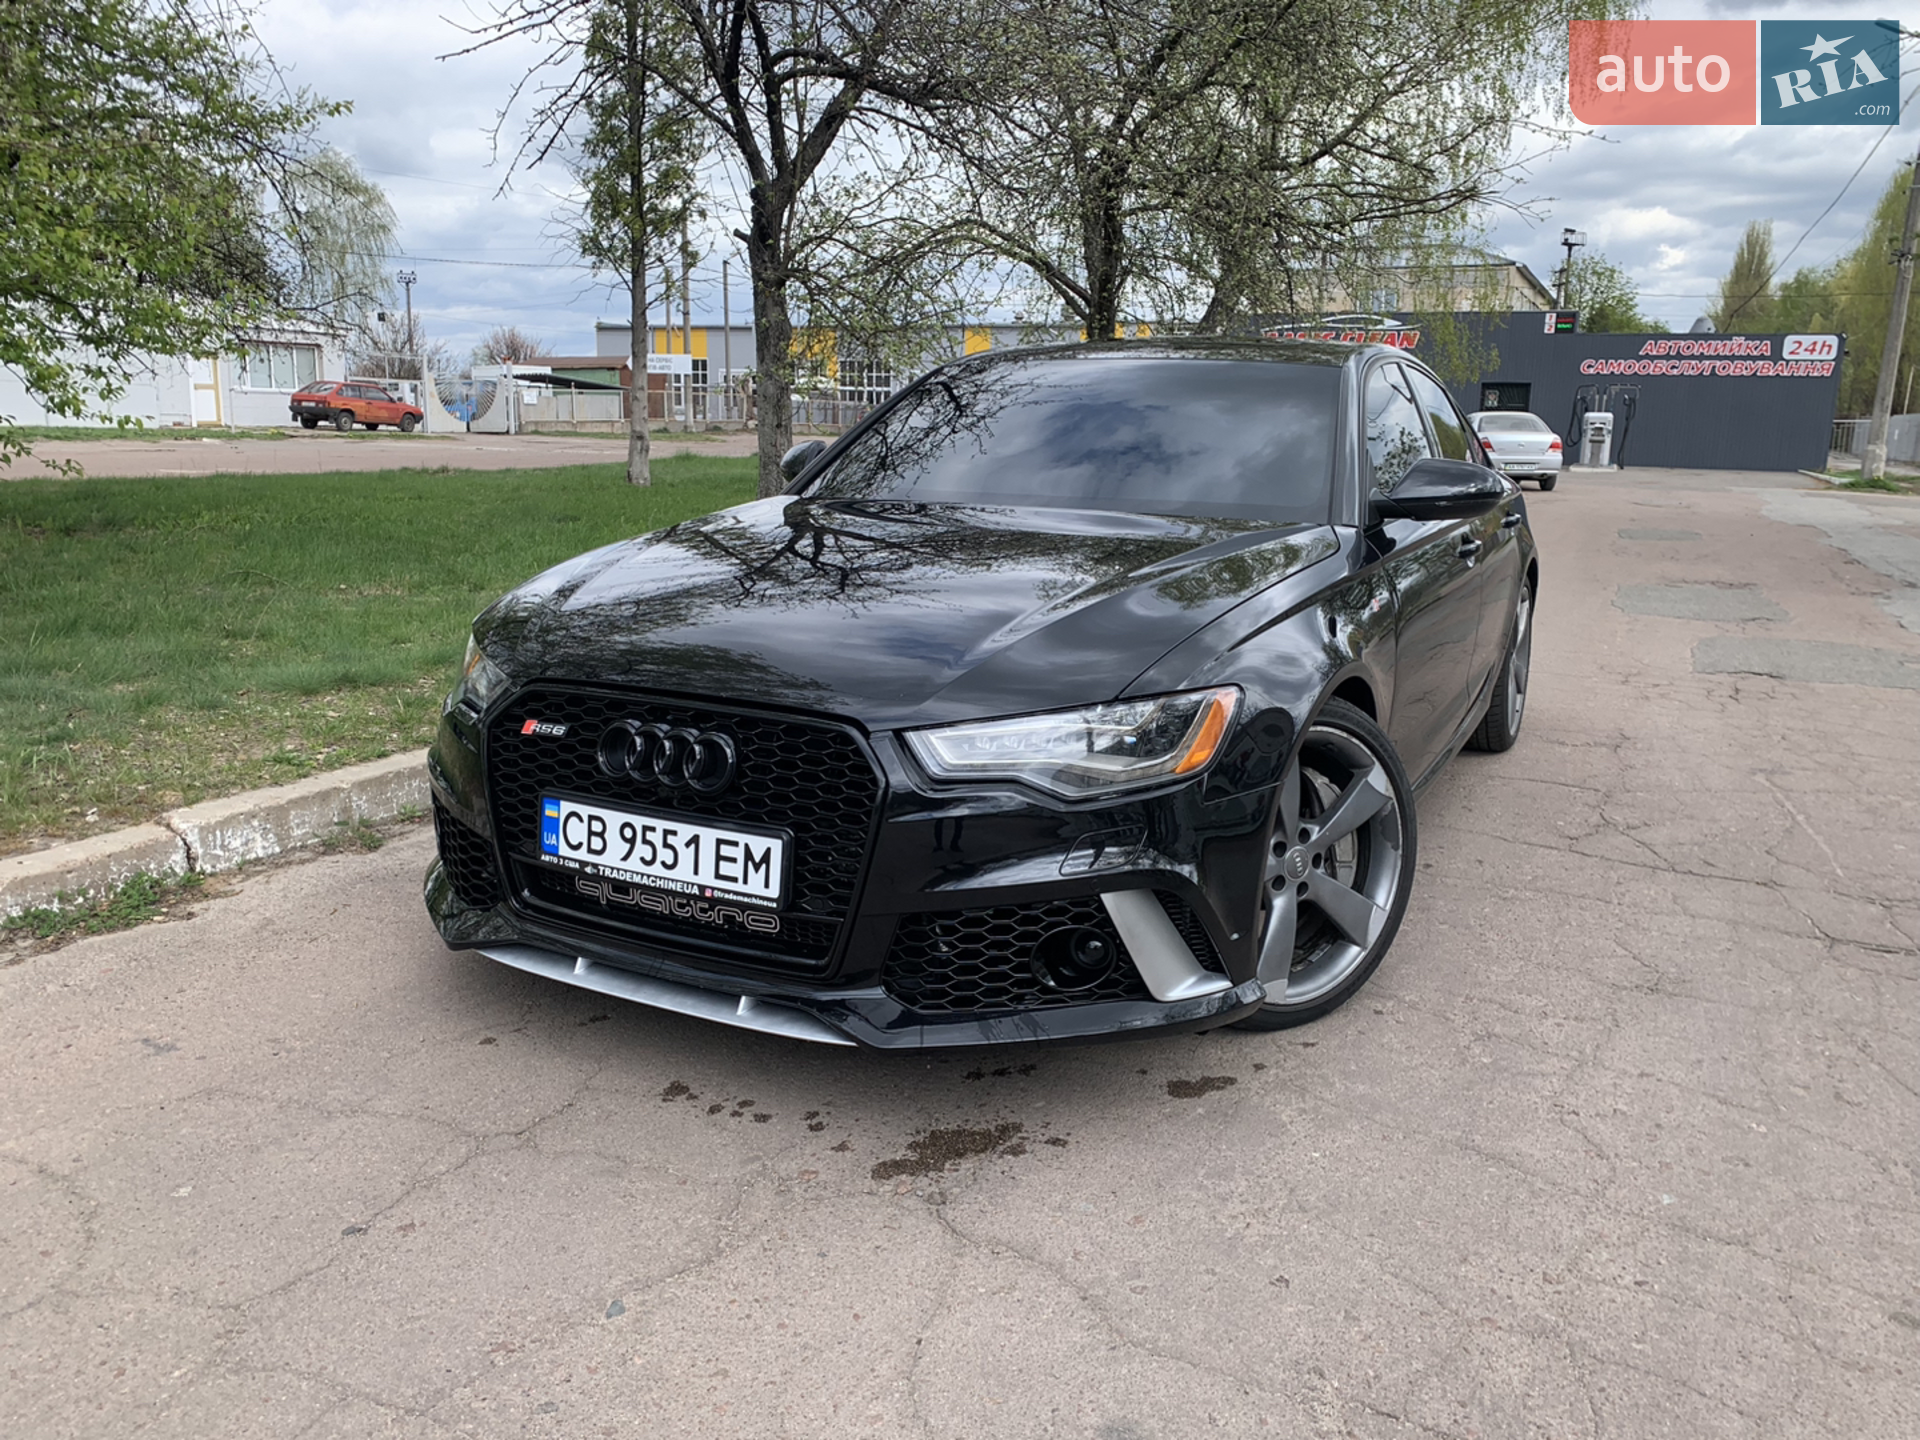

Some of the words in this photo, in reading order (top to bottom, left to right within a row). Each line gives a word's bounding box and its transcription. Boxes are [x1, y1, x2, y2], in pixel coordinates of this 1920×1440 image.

[1640, 337, 1771, 356] АВТОМИЙКА
[1788, 340, 1833, 356] 24h
[1580, 359, 1835, 376] САМООБСЛУГОВУВАННЯ
[530, 723, 566, 736] RS6
[544, 832, 557, 846] UA
[541, 854, 558, 864] АВТО
[562, 811, 608, 856] CB
[619, 821, 701, 876] 9551
[714, 837, 772, 890] EM
[598, 865, 700, 896] TRADEMACHINEUA
[575, 875, 780, 933] quattro
